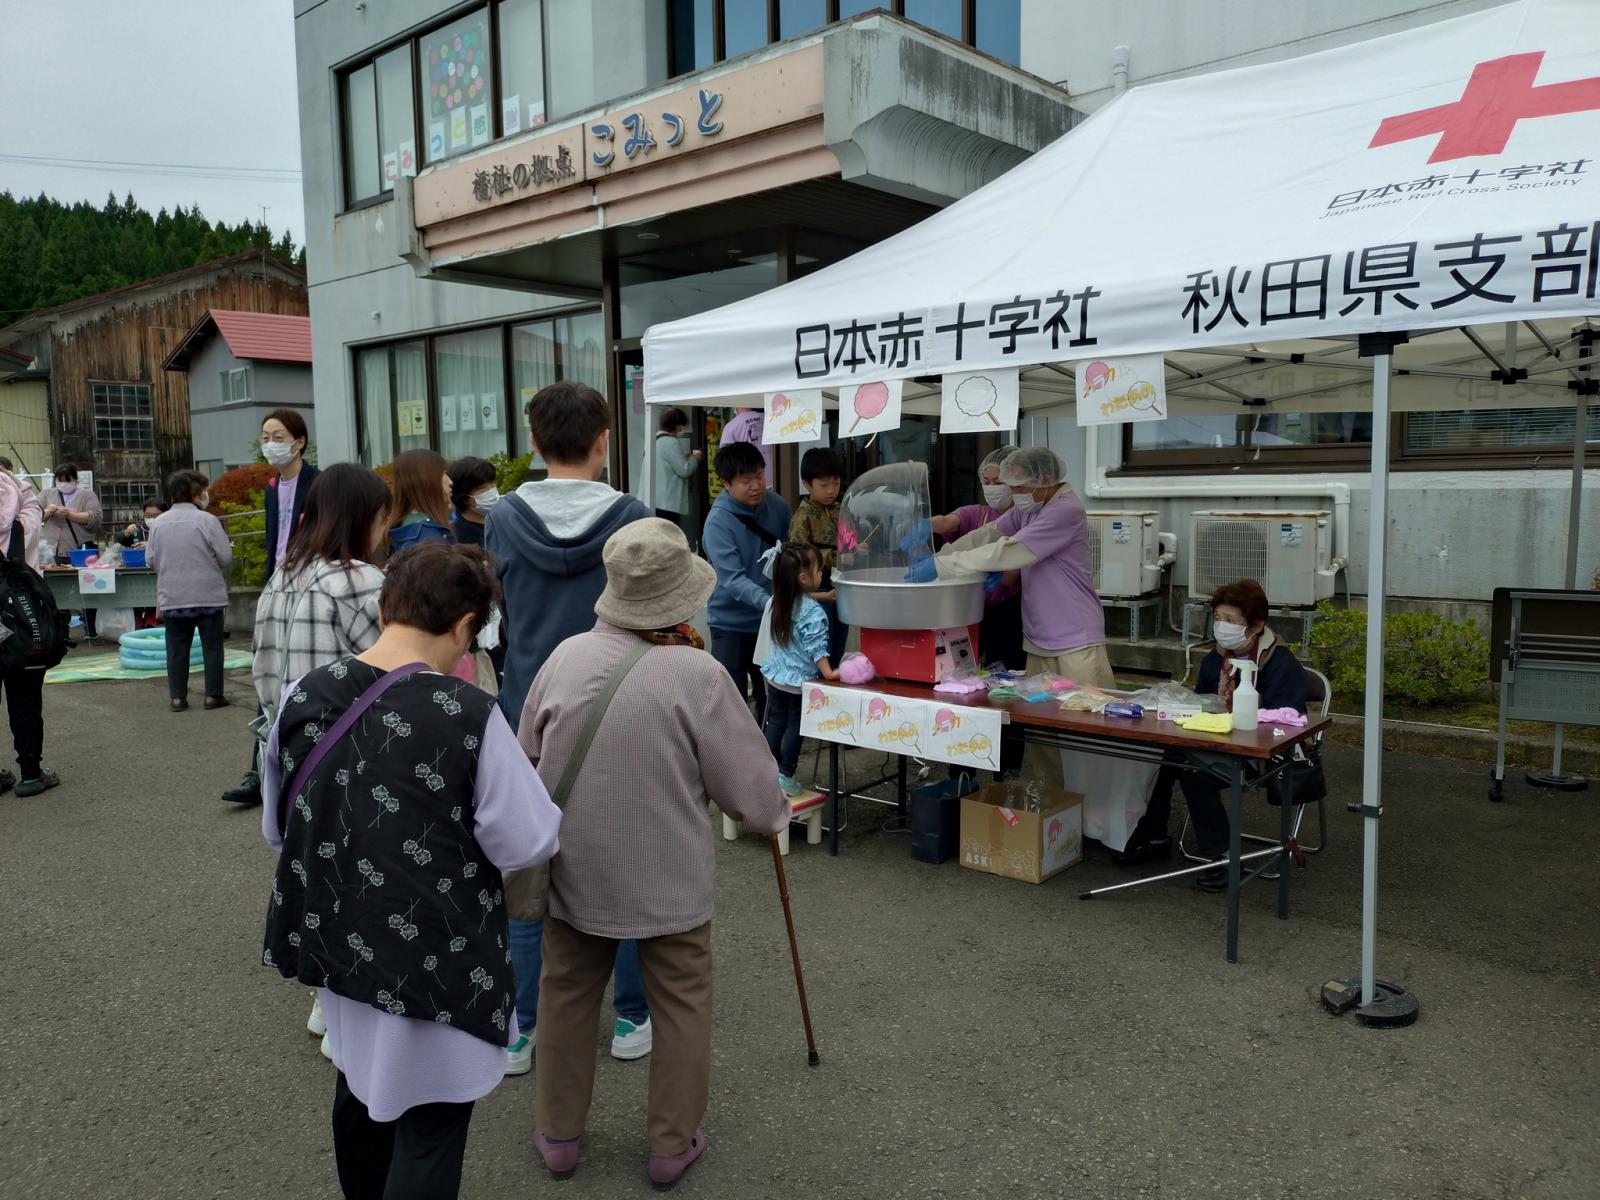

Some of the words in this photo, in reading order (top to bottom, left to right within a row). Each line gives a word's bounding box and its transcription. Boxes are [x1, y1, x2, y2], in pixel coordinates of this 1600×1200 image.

[472, 144, 577, 202] 福祉の拠点
[1319, 198, 1403, 219] Japanese
[1409, 189, 1443, 201] Red
[1447, 186, 1502, 197] Cross
[1506, 178, 1584, 191] Society
[1327, 159, 1593, 210] 日本赤十字社
[794, 285, 1102, 380] 日本赤十字社
[1180, 220, 1600, 334] 秋田県支部
